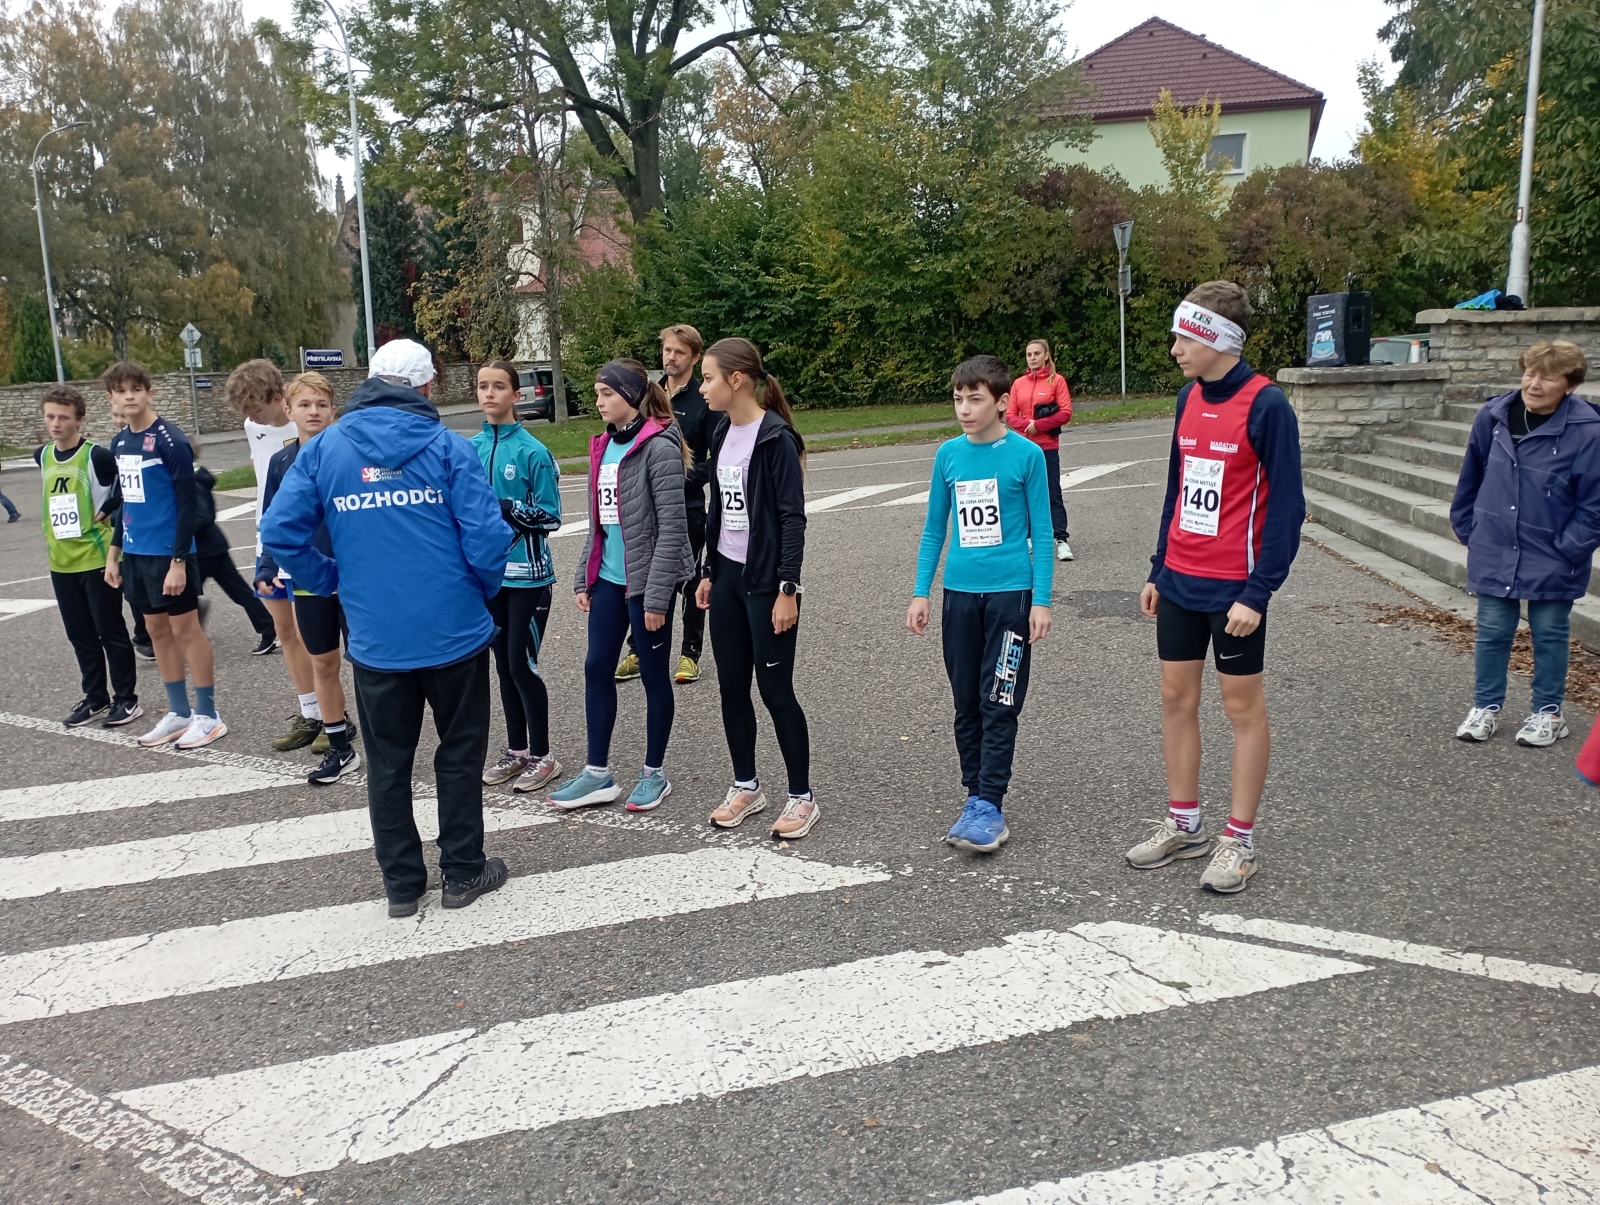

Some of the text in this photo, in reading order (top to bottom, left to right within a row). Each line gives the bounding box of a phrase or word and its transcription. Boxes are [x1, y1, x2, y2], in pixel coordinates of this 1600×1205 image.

[1179, 317, 1219, 339] MARATON
[1192, 310, 1213, 325] LES
[1210, 440, 1238, 450] MARATON
[120, 474, 140, 488] 211
[333, 485, 444, 512] ROZHODČÍ
[1183, 485, 1219, 512] 140
[51, 511, 78, 526] 209
[959, 505, 999, 527] 103
[998, 631, 1023, 706] LEADER
